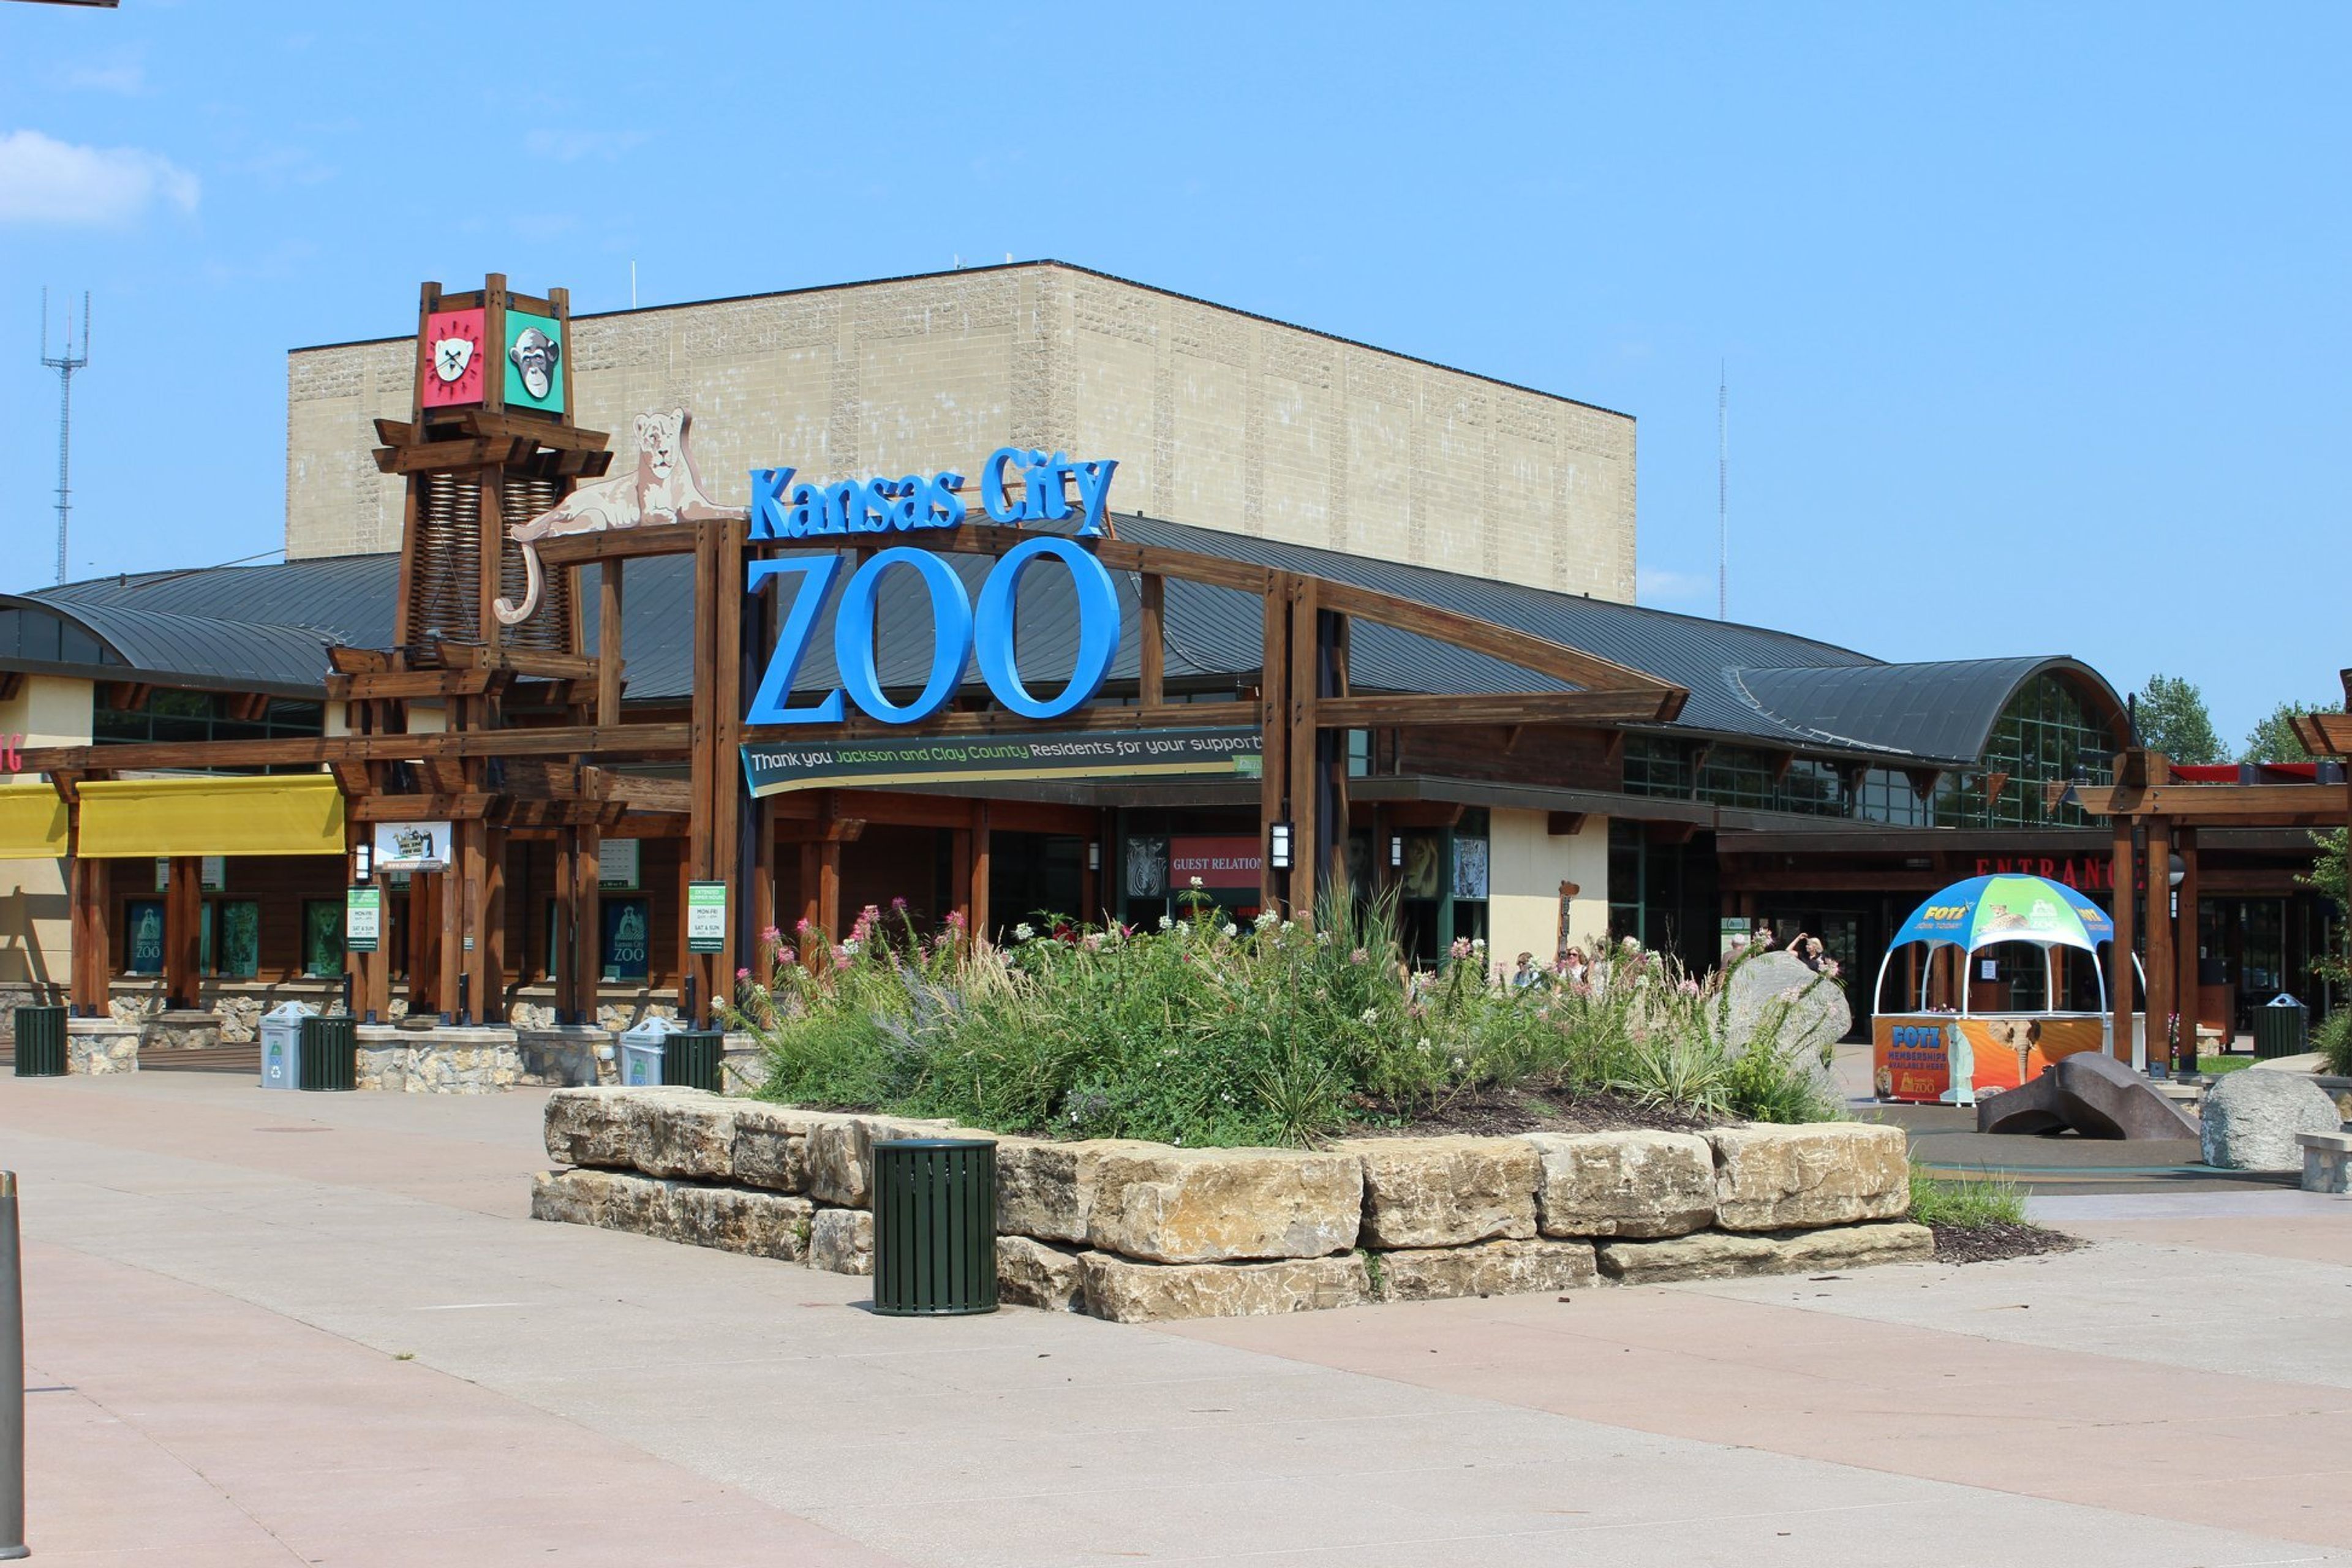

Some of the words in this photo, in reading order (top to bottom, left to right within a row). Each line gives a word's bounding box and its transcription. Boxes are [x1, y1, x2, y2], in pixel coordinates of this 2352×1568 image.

[747, 467, 965, 540] Kansas
[981, 447, 1120, 537] City
[745, 536, 1121, 725] ZOO
[751, 752, 801, 772] Thank
[801, 752, 834, 767] you
[835, 748, 899, 764] Jackson
[899, 748, 930, 761] and
[931, 747, 968, 762] Clay
[968, 745, 1030, 759] County
[1029, 742, 1115, 757] Residents
[1116, 741, 1142, 756] for
[1145, 739, 1186, 755] your
[1173, 858, 1210, 870] GUEST
[136, 946, 160, 958] ZOO
[614, 948, 644, 962] ZOO
[1892, 1025, 1941, 1049] FOTZ
[1888, 1051, 1947, 1061] MEMBERSHIPS
[1914, 1082, 1935, 1093] ZOO
